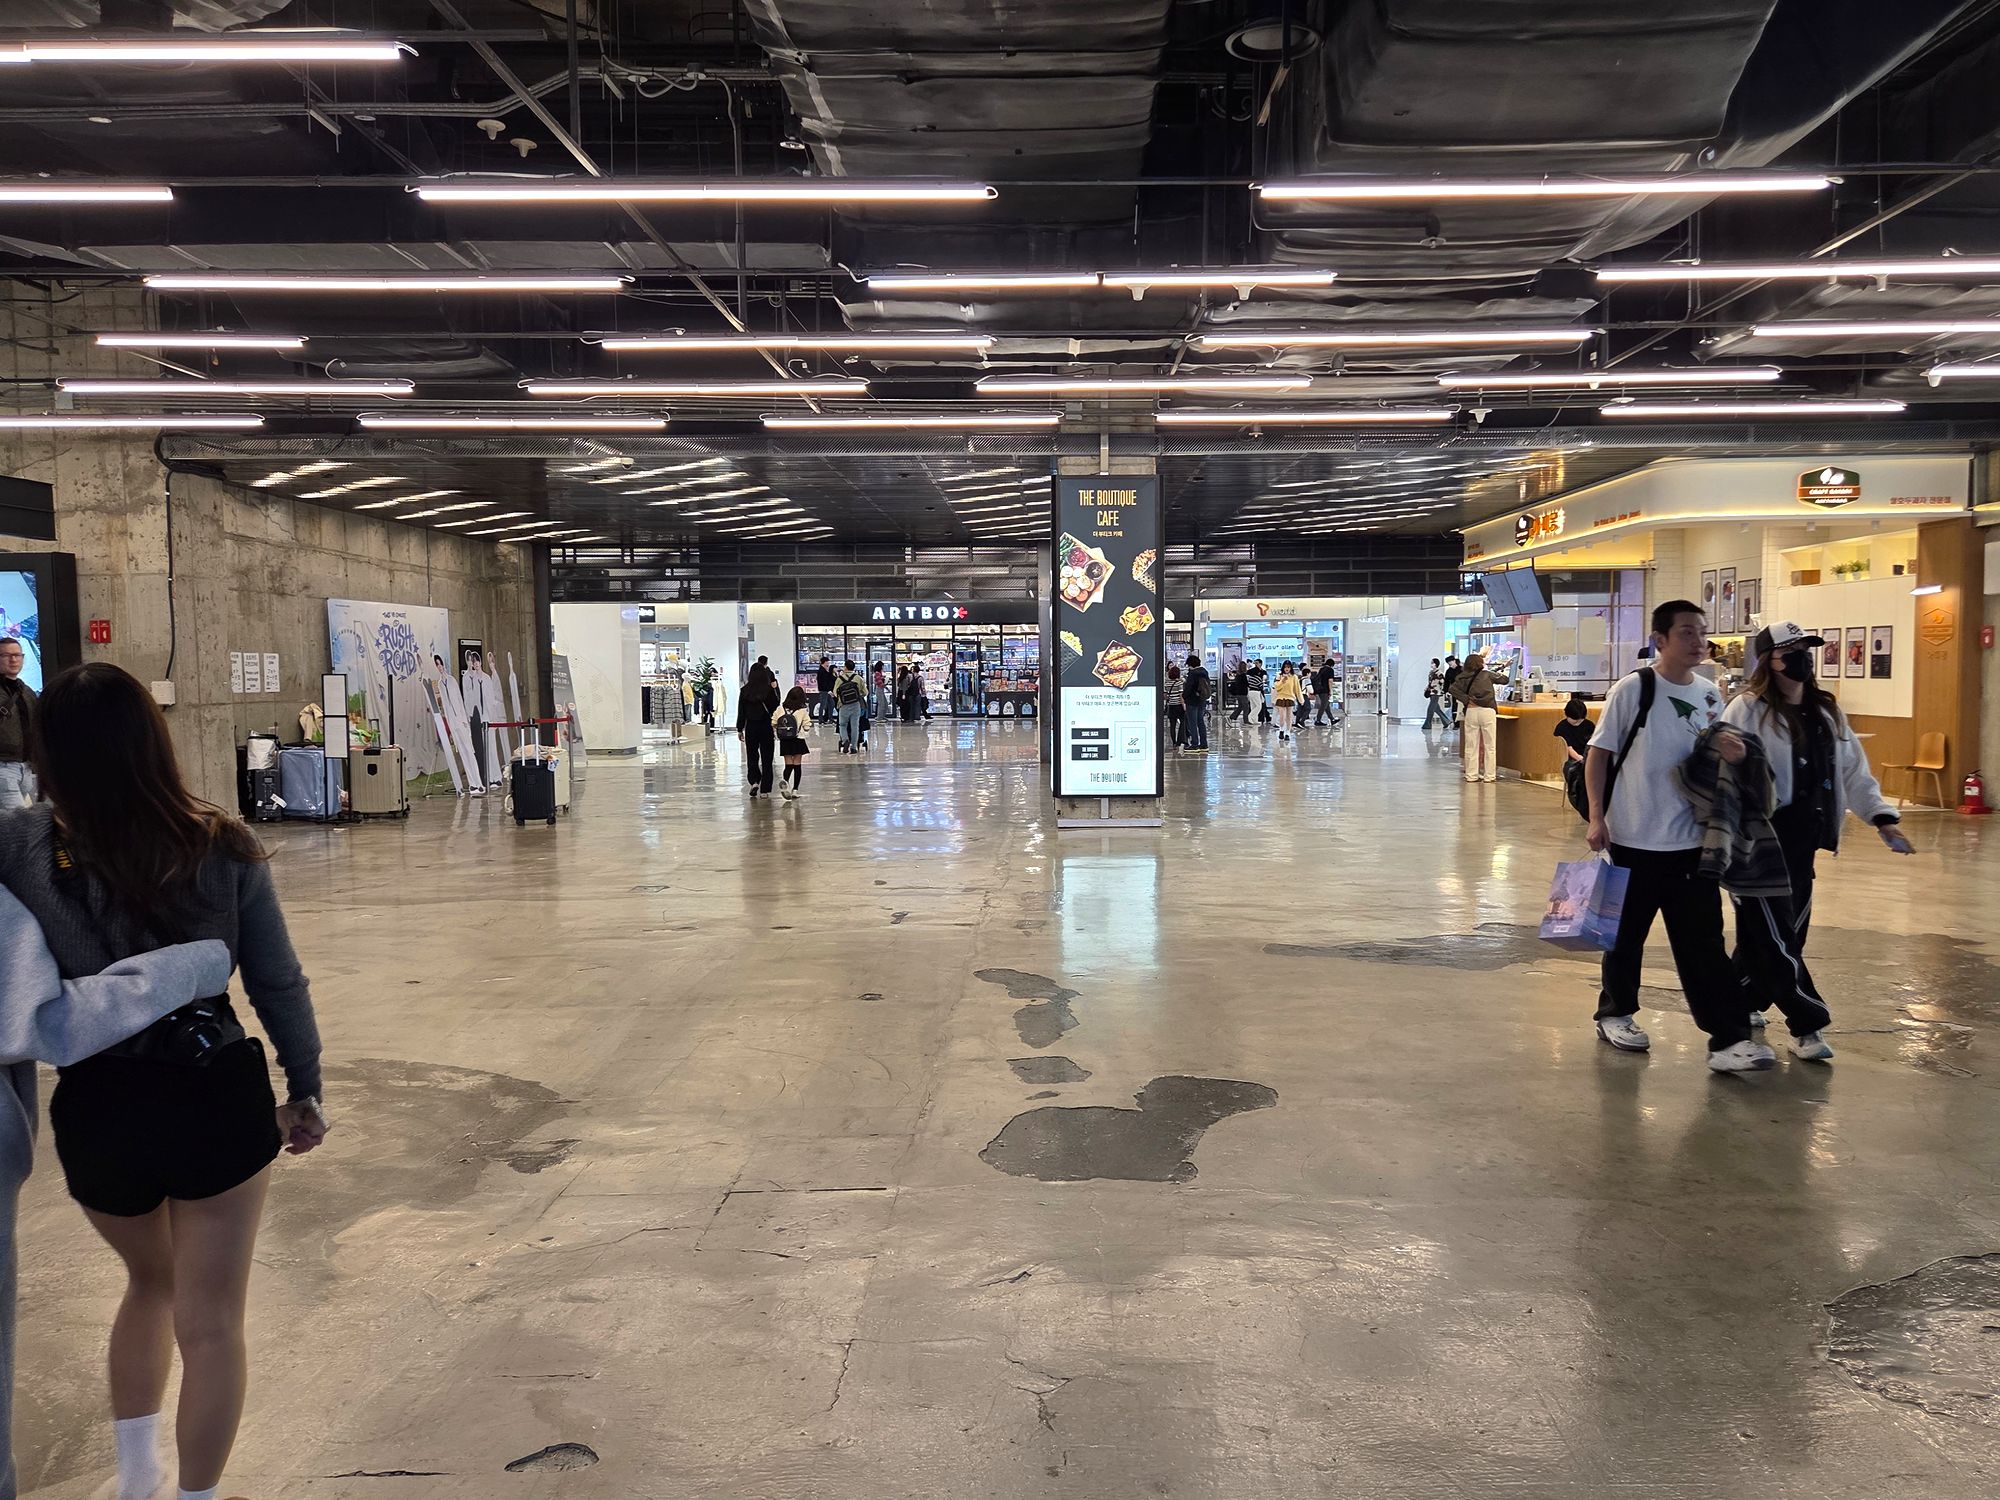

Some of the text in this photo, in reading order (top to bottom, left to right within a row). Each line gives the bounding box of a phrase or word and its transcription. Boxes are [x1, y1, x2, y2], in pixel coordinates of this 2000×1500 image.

[1079, 490, 1137, 507] THE BOUTIQUE
[1097, 511, 1119, 526] CAFE
[872, 606, 968, 620] ARTBOX
[1271, 605, 1297, 616] world
[379, 622, 415, 652] RUSH
[379, 649, 418, 678] ROAD
[1090, 773, 1128, 783] THE BOUTIQUE
